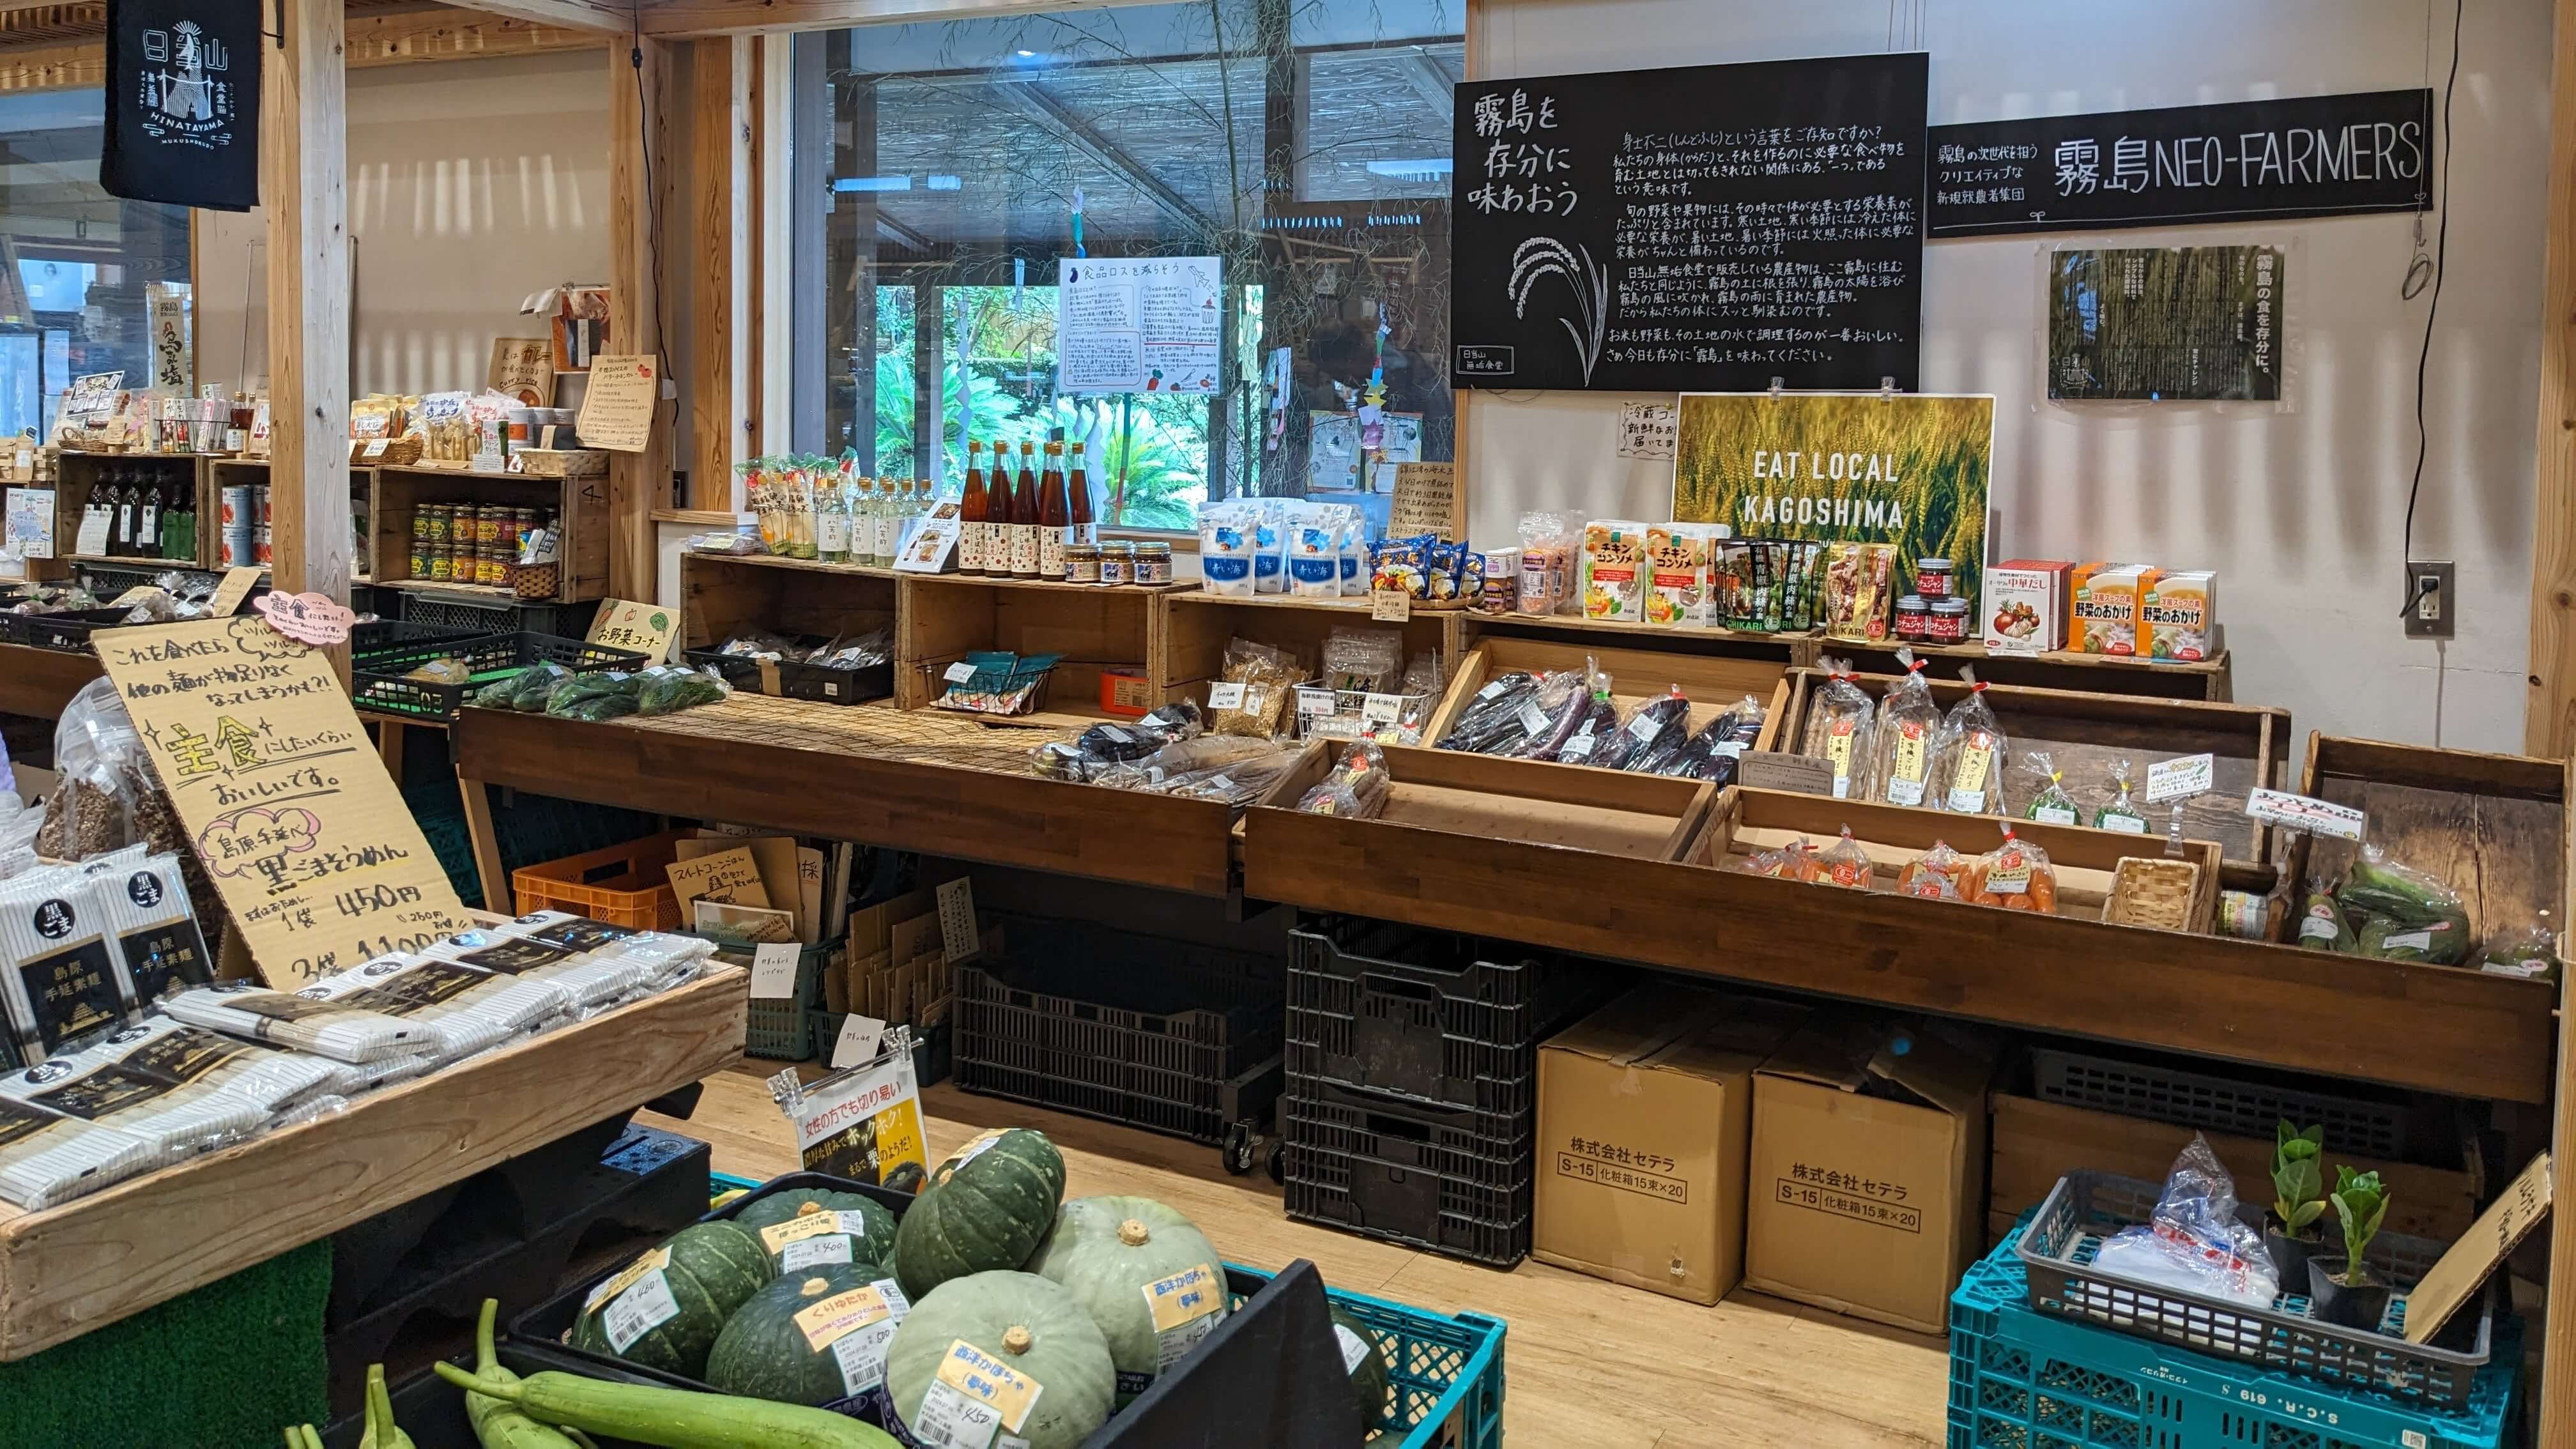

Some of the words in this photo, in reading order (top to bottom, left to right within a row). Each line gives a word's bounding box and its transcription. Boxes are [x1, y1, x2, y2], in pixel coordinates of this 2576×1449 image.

[151, 111, 225, 132] HINATAYAMA
[1474, 88, 1558, 137] 霧島を
[1483, 141, 1571, 178] 存分に
[1939, 165, 2023, 183] クリエイティブな
[1467, 182, 1579, 217] 味わおう
[1082, 261, 1180, 280] 食品ロスを減らそう
[2255, 255, 2274, 373] 霧島の食を存分に。
[1628, 422, 1676, 435] 新鮮なお
[1754, 450, 1800, 479] EAT
[1813, 452, 1899, 482] LOCAL
[1744, 495, 1903, 529] KAGOSHIMA
[1597, 553, 1633, 565] コンソメ
[1601, 543, 1636, 554] チキン
[1660, 548, 1690, 559] チキン
[1657, 558, 1692, 569] コンソメ
[2075, 602, 2133, 620] 野菜のおかげ
[2143, 606, 2202, 625] 野菜のおかげ
[112, 640, 231, 666] これを食べたら
[210, 767, 341, 807] おいしいです。
[256, 844, 409, 887] 黒ごまそうめん
[335, 884, 422, 917] 450円
[805, 1080, 902, 1139] 女性の方でも切り易い
[1570, 1136, 1676, 1173] 株式会社セテラ
[1561, 1158, 1595, 1177] S-15
[1791, 1162, 1908, 1200] 株式会社セテラ
[1781, 1184, 1818, 1204] S-15
[823, 1241, 842, 1253] 400
[962, 1407, 990, 1424] 450
